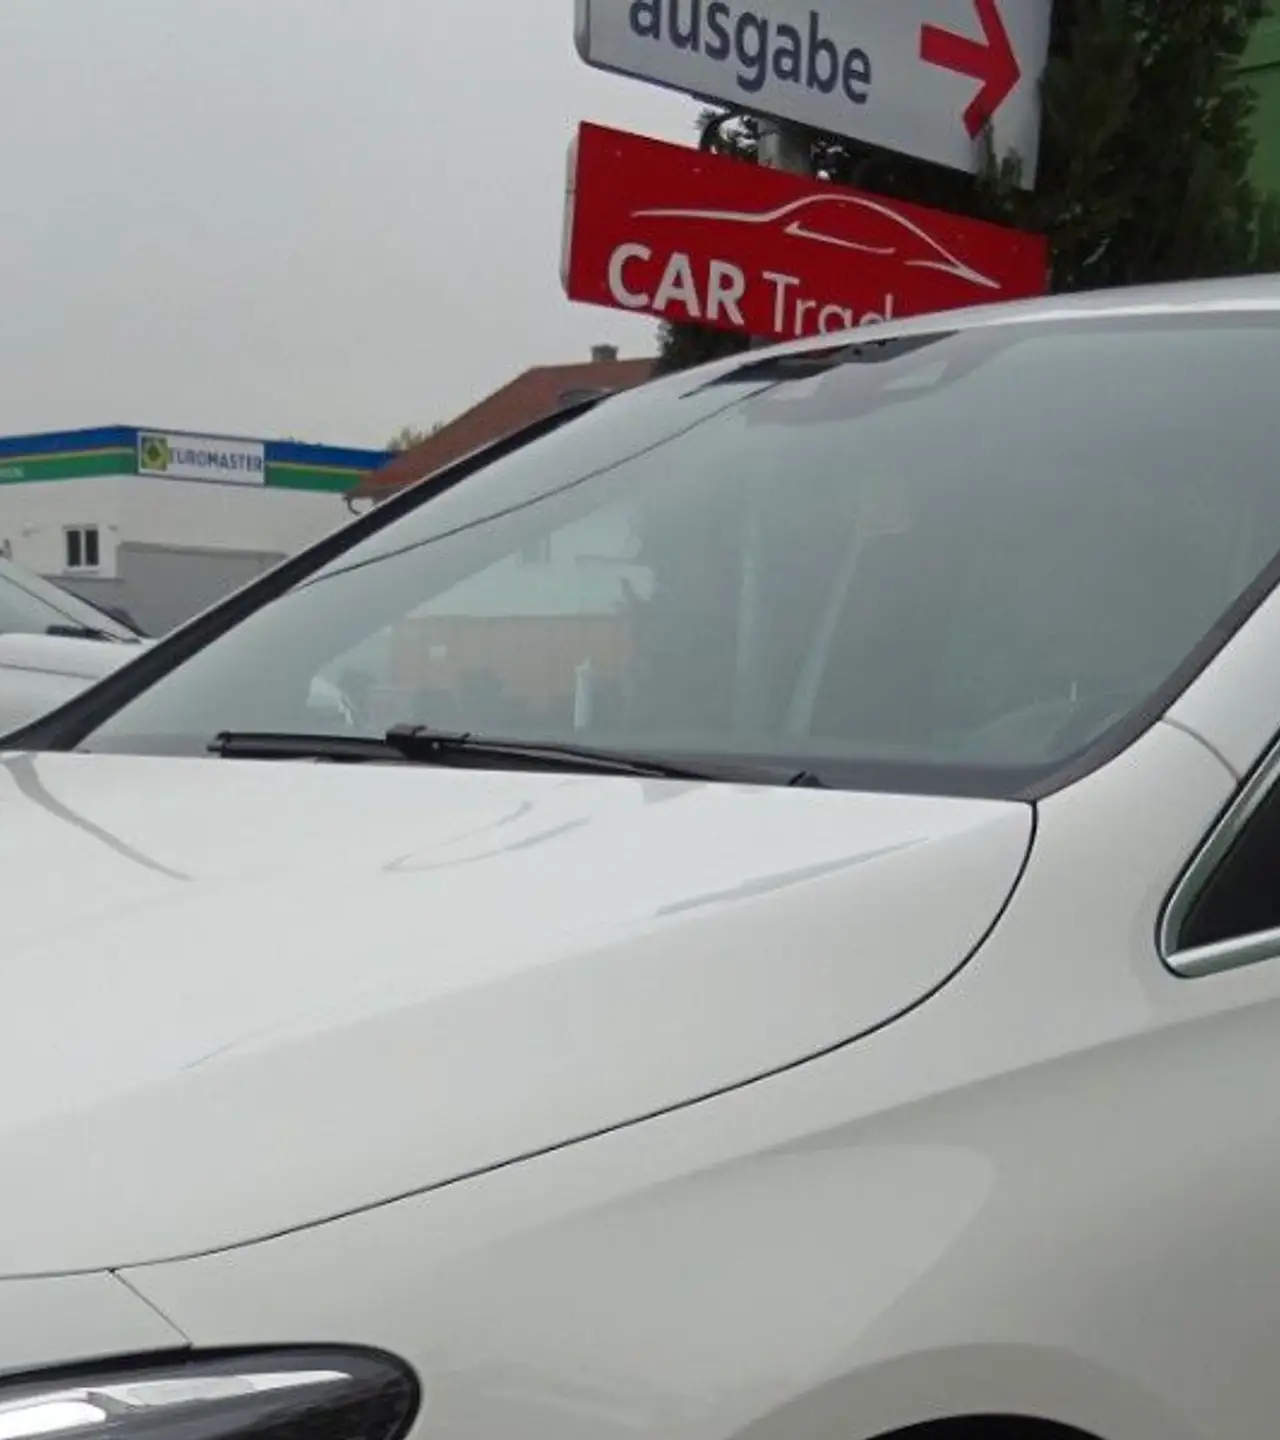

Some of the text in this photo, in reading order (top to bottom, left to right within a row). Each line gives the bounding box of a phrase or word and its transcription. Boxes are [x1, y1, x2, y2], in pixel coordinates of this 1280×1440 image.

[628, 0, 872, 104] ausgabe
[608, 242, 745, 326] CAR
[169, 447, 263, 474] EUROMASTER
